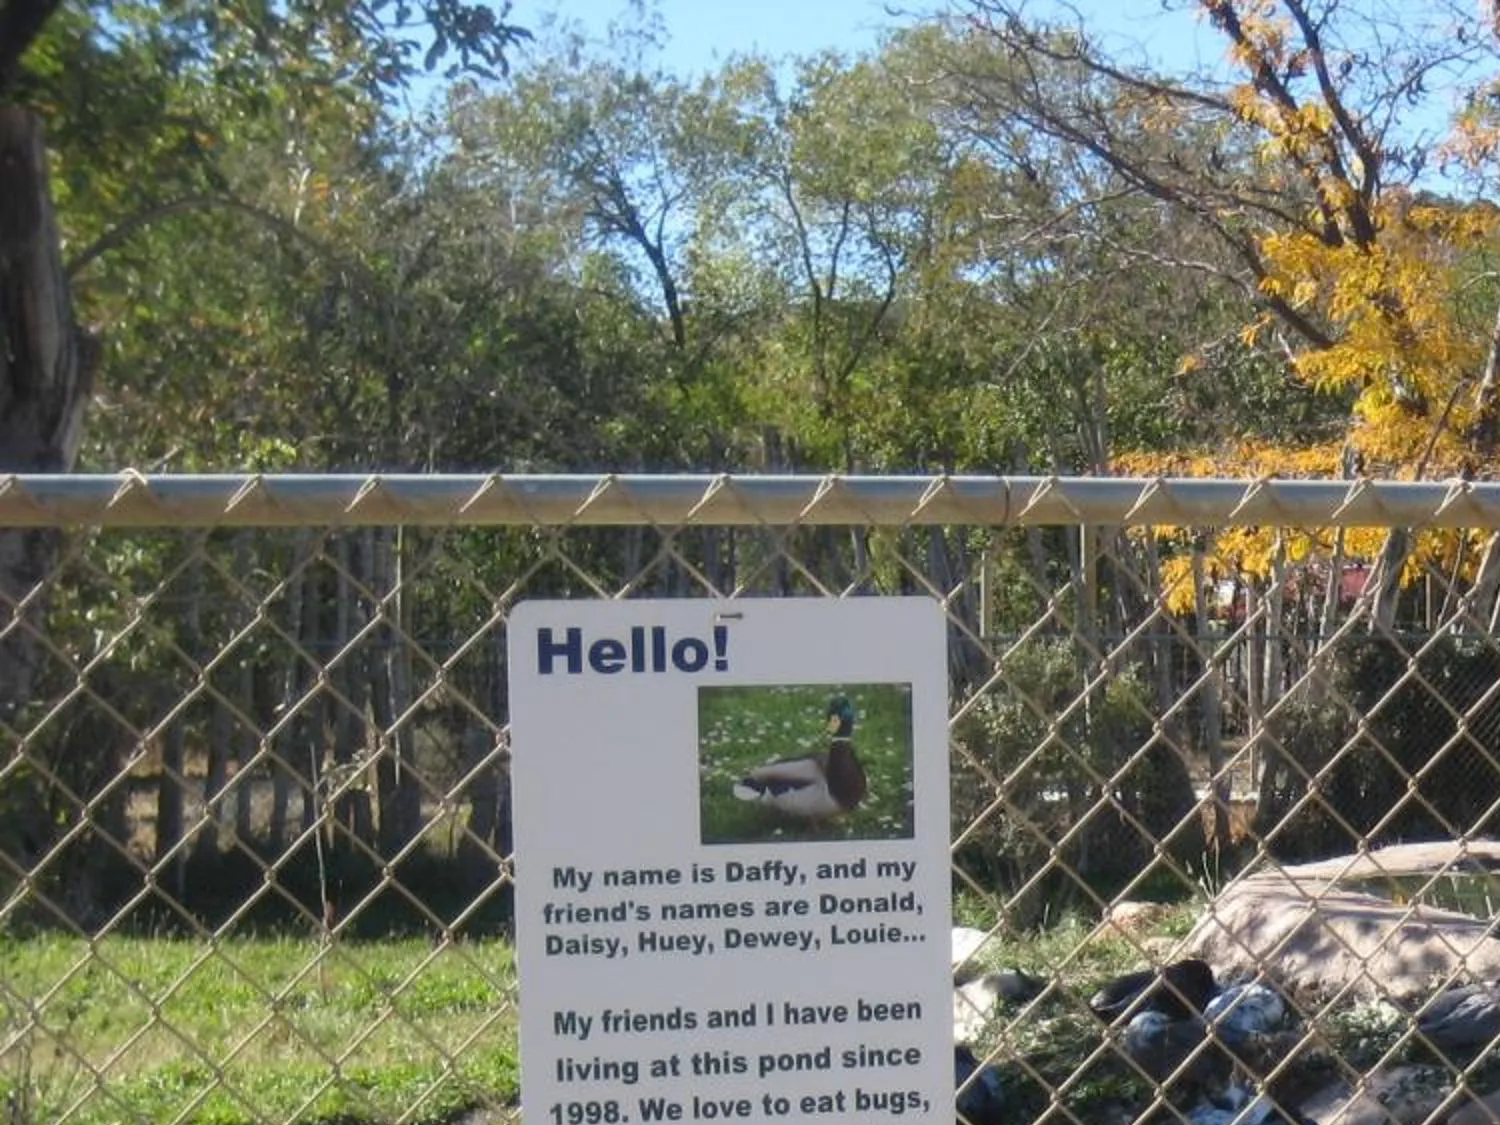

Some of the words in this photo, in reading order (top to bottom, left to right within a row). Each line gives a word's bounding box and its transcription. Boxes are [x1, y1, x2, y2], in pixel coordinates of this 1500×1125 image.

[537, 625, 728, 675] Hello!
[553, 867, 592, 893] My
[604, 869, 681, 887] name
[692, 863, 715, 884] is
[726, 860, 806, 886] Daffy,
[816, 858, 866, 880] and
[877, 860, 916, 883] my
[543, 901, 651, 924] friend's
[661, 902, 754, 921] names
[765, 899, 809, 917] are
[820, 891, 923, 915] Donald,
[546, 934, 628, 959] Daisy,
[638, 931, 714, 957] Huey,
[724, 927, 820, 952] Dewey,
[831, 923, 926, 945] Louie...
[554, 1011, 592, 1040] My
[602, 1009, 698, 1034] friends
[707, 1003, 756, 1030] and
[767, 1003, 774, 1026] I
[784, 1002, 848, 1025] have
[858, 999, 921, 1022] been
[557, 1057, 638, 1085] living
[650, 1054, 680, 1078] at
[691, 1051, 748, 1076] this
[759, 1046, 831, 1079] pond
[842, 1044, 921, 1069] since
[639, 1098, 682, 1123] We
[693, 1096, 752, 1119] love
[762, 1094, 790, 1117] to
[800, 1090, 845, 1115] eat
[856, 1088, 929, 1115] bugs,
